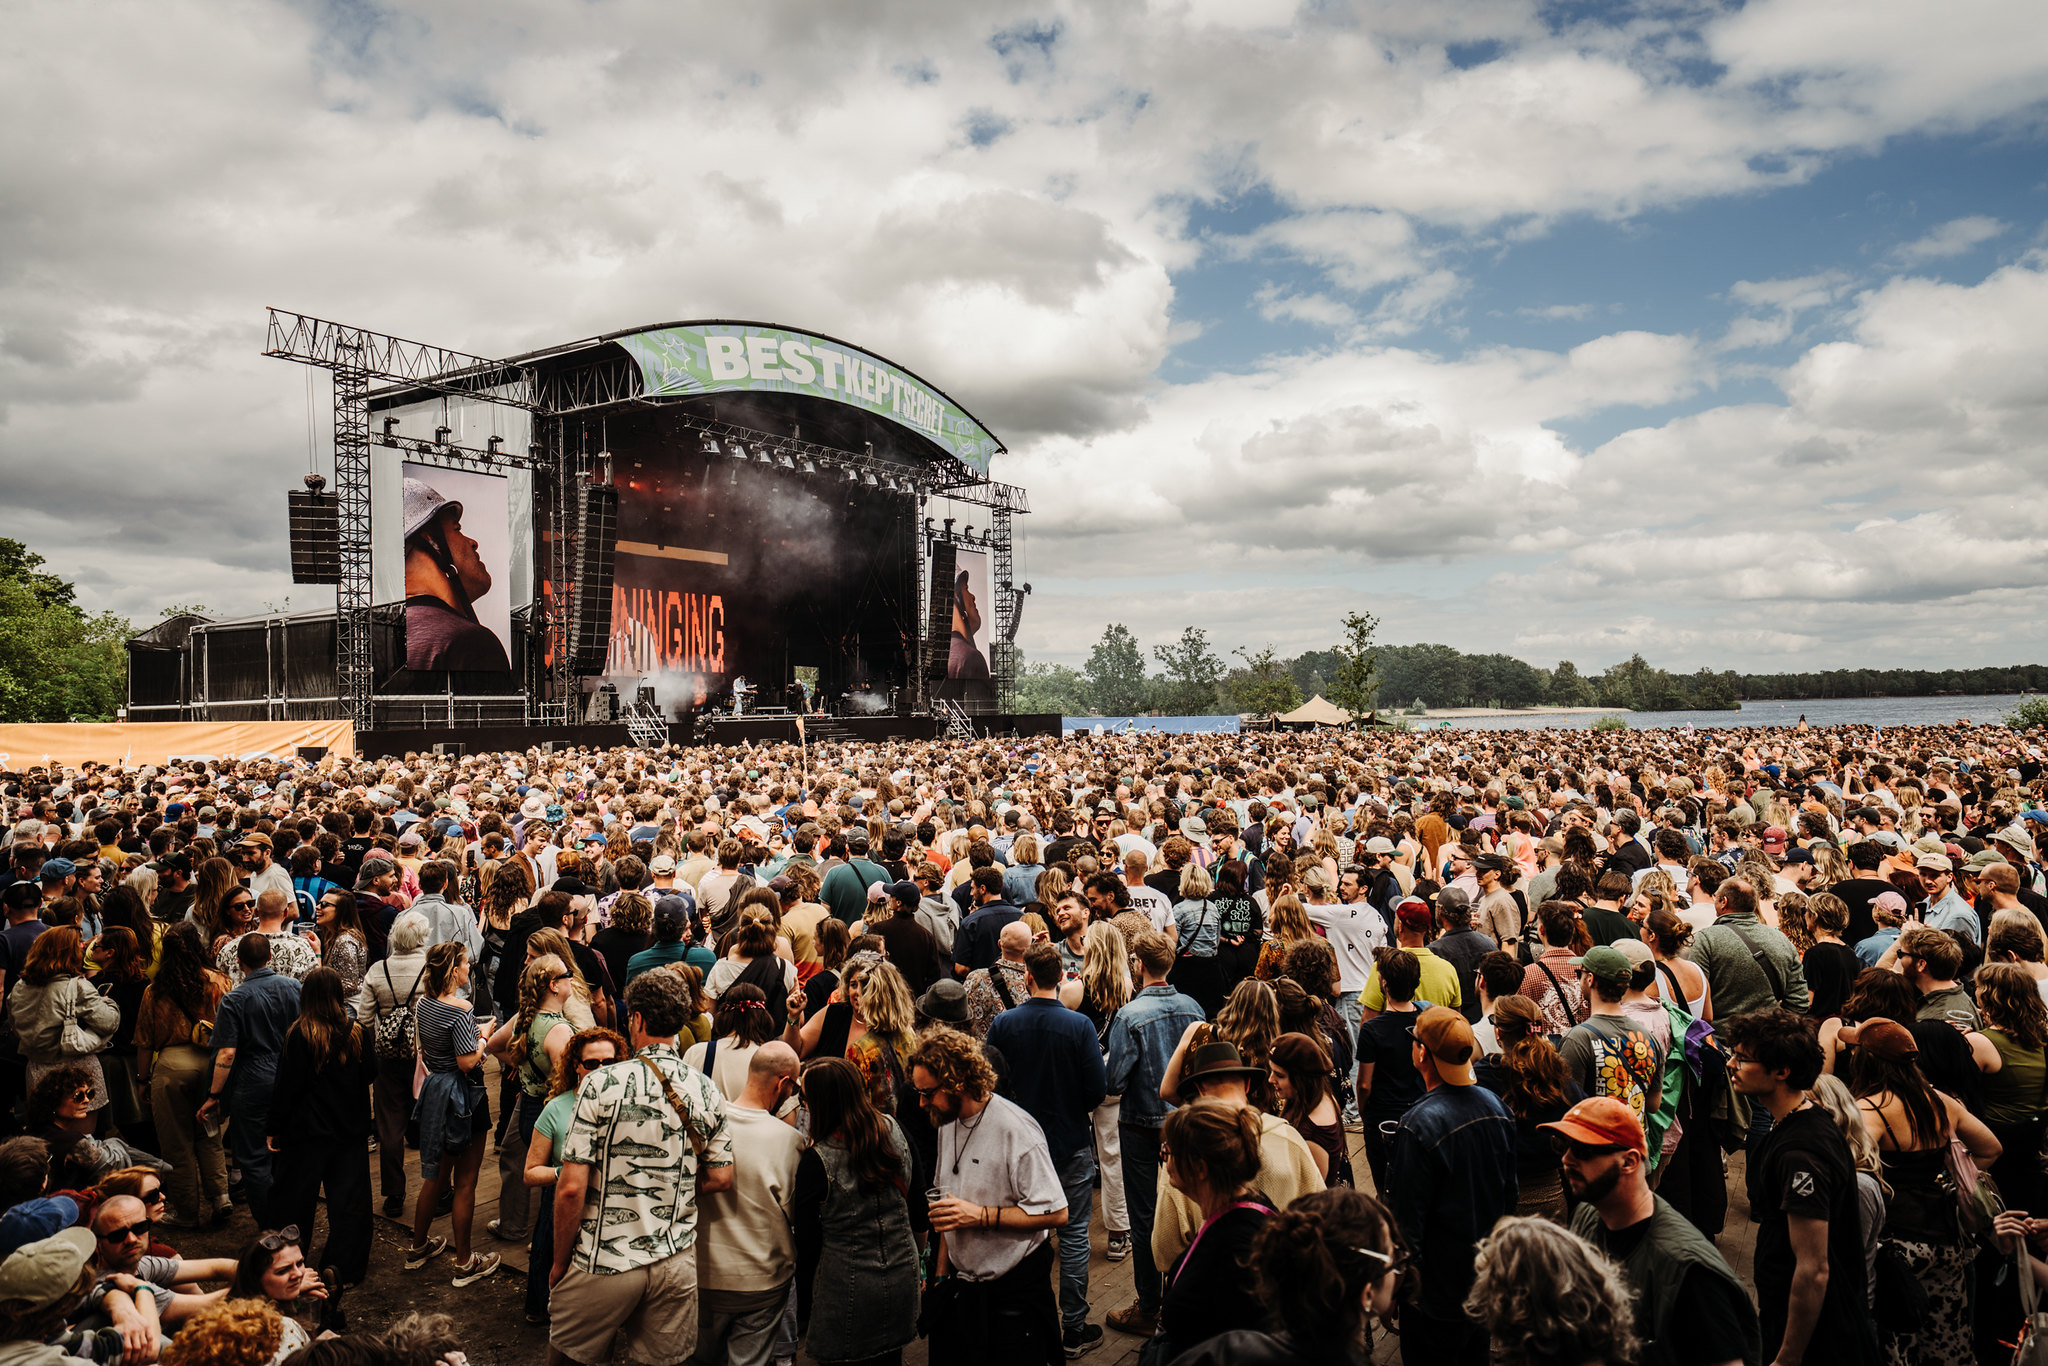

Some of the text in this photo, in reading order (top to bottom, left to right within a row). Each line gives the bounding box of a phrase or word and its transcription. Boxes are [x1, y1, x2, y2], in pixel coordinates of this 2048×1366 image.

[704, 336, 945, 438] BEST KEPT SECRET
[1591, 1039, 1606, 1097] ERTIME
